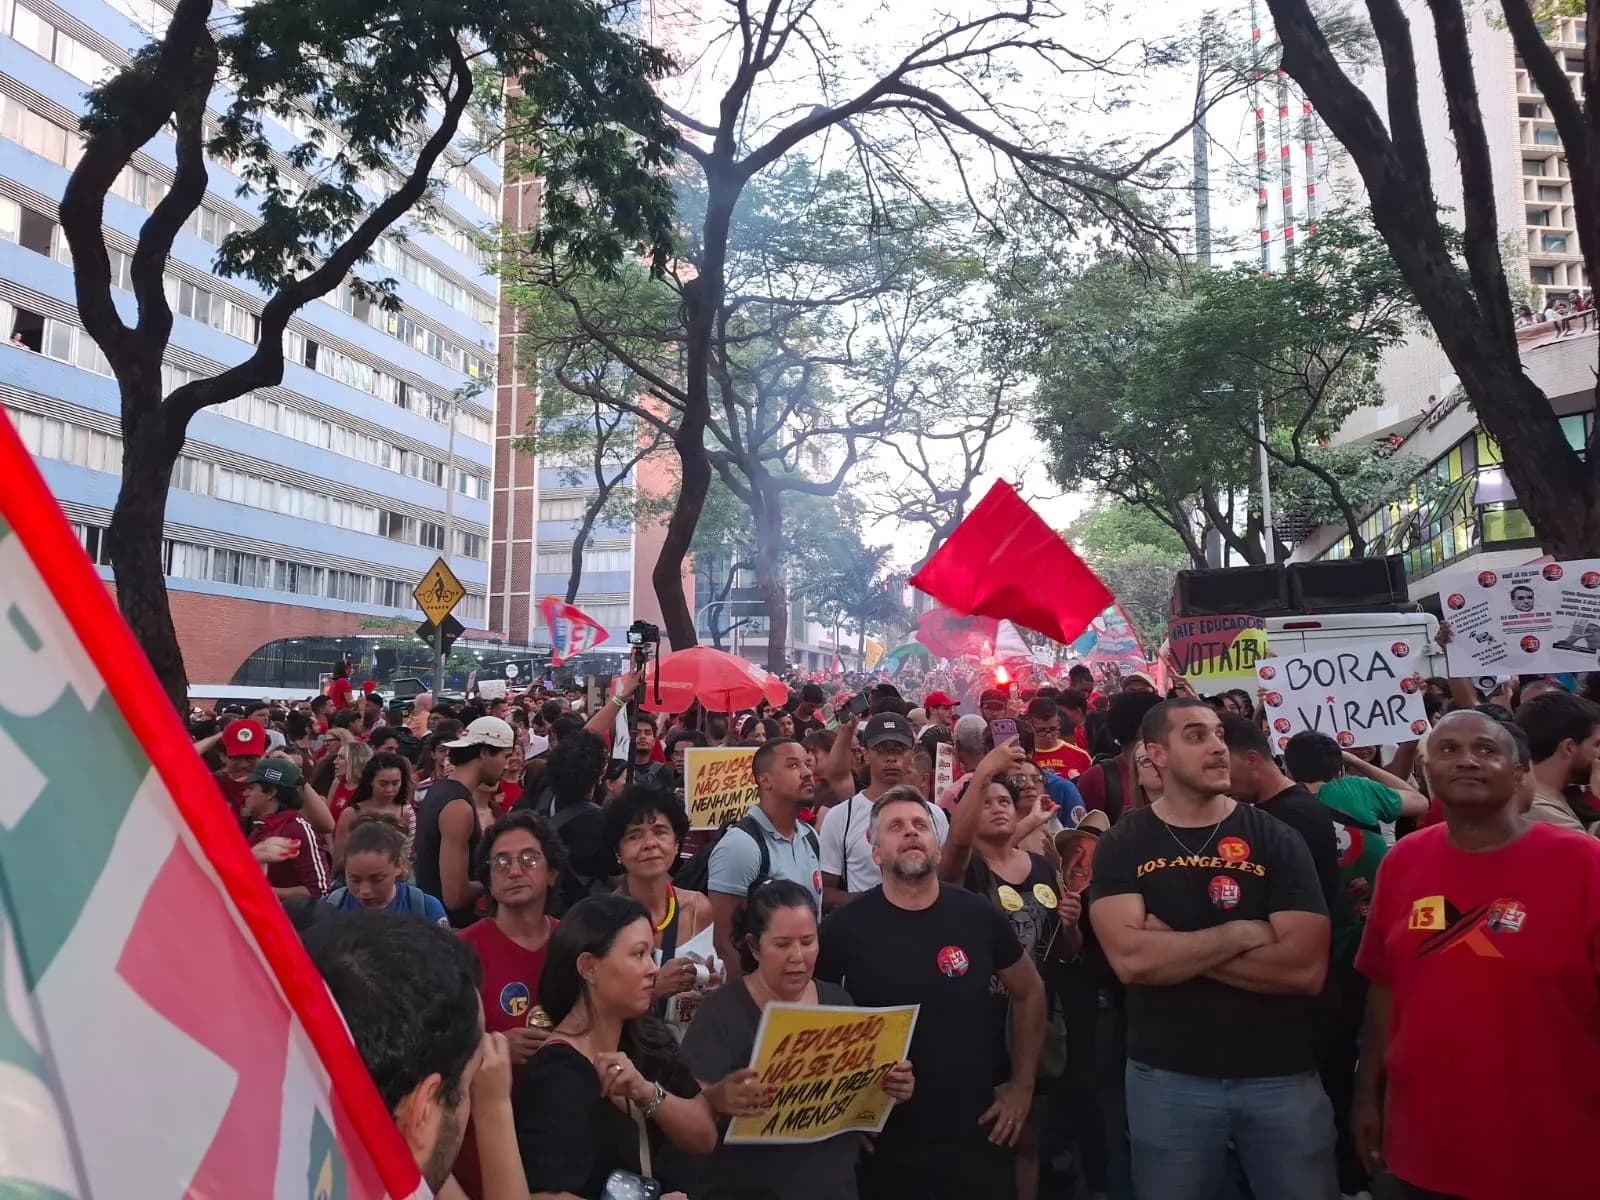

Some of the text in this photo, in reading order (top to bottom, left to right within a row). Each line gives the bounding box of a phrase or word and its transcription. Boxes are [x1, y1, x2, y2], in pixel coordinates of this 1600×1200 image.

[1168, 640, 1234, 676] VOTA
[1285, 650, 1396, 691] BORA
[696, 764, 707, 781] A
[694, 777, 720, 798] NÃO
[721, 774, 739, 791] SE
[690, 789, 743, 814] NENHUM
[706, 811, 716, 827] A
[1221, 842, 1246, 858] 13
[1136, 855, 1267, 879] LOS ANGELES
[1411, 906, 1435, 928] 13
[771, 1032, 793, 1059] A
[760, 1055, 804, 1084] NÃO
[803, 1052, 835, 1080] SE
[760, 1111, 781, 1137] A
